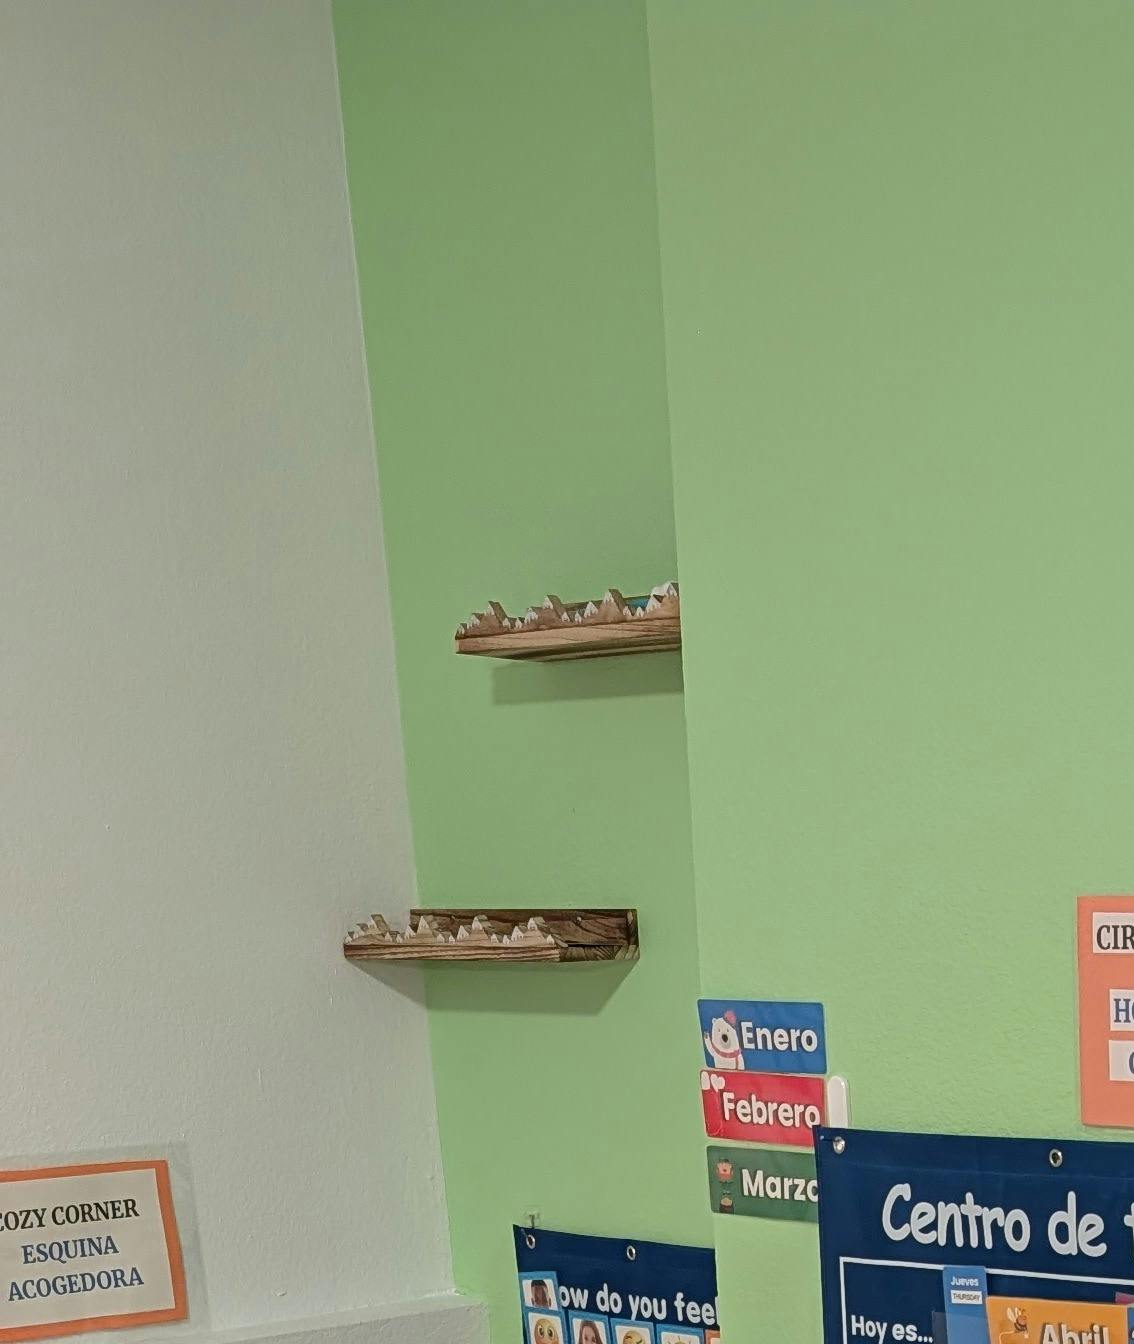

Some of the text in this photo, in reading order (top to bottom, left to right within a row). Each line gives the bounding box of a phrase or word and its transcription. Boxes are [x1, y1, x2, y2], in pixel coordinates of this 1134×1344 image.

[741, 1021, 818, 1052] Enero
[722, 1091, 820, 1128] Febrero
[52, 1199, 140, 1226] CORNER
[882, 1183, 1030, 1251] Centro
[1048, 1191, 1107, 1257] de
[22, 1235, 119, 1264] ESQUINA
[8, 1266, 144, 1301] ACOGEDORA
[950, 1276, 980, 1287] Jueves
[559, 1283, 718, 1326] ow do you fee
[851, 1315, 934, 1344] Hoy es...
